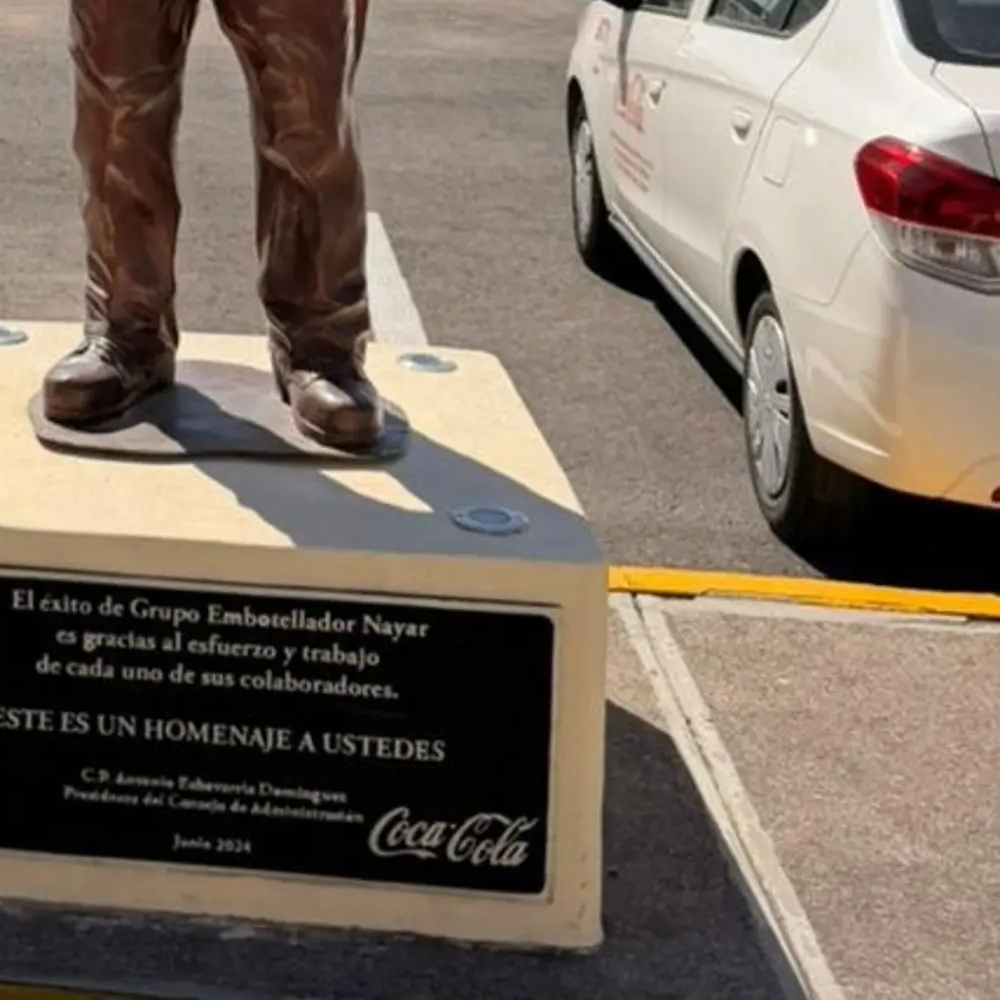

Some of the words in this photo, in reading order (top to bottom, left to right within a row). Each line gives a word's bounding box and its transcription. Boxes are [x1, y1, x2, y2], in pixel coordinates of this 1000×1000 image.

[12, 588, 35, 611] El
[39, 592, 93, 616] éxito
[98, 594, 125, 618] de
[129, 597, 201, 628] Grupo
[207, 603, 357, 634] Embotellador
[362, 612, 430, 643] Nayar
[55, 629, 78, 645] es
[82, 629, 157, 653] gracias
[161, 630, 182, 652] al
[187, 633, 277, 660] esfuerzo
[283, 646, 297, 666] y
[302, 642, 381, 672] trabajo
[35, 653, 62, 676] de
[65, 656, 115, 679] cada
[121, 665, 163, 683] uno
[168, 662, 196, 685] de
[201, 670, 235, 688] sus
[239, 668, 400, 700] colaboradores.
[60, 711, 90, 735] ES
[96, 713, 138, 738] UN
[143, 717, 292, 754] HOMENAJE
[298, 730, 317, 754] A
[321, 731, 448, 763] USTEDES
[229, 798, 249, 814] de
[367, 805, 540, 867] Coca-Cola
